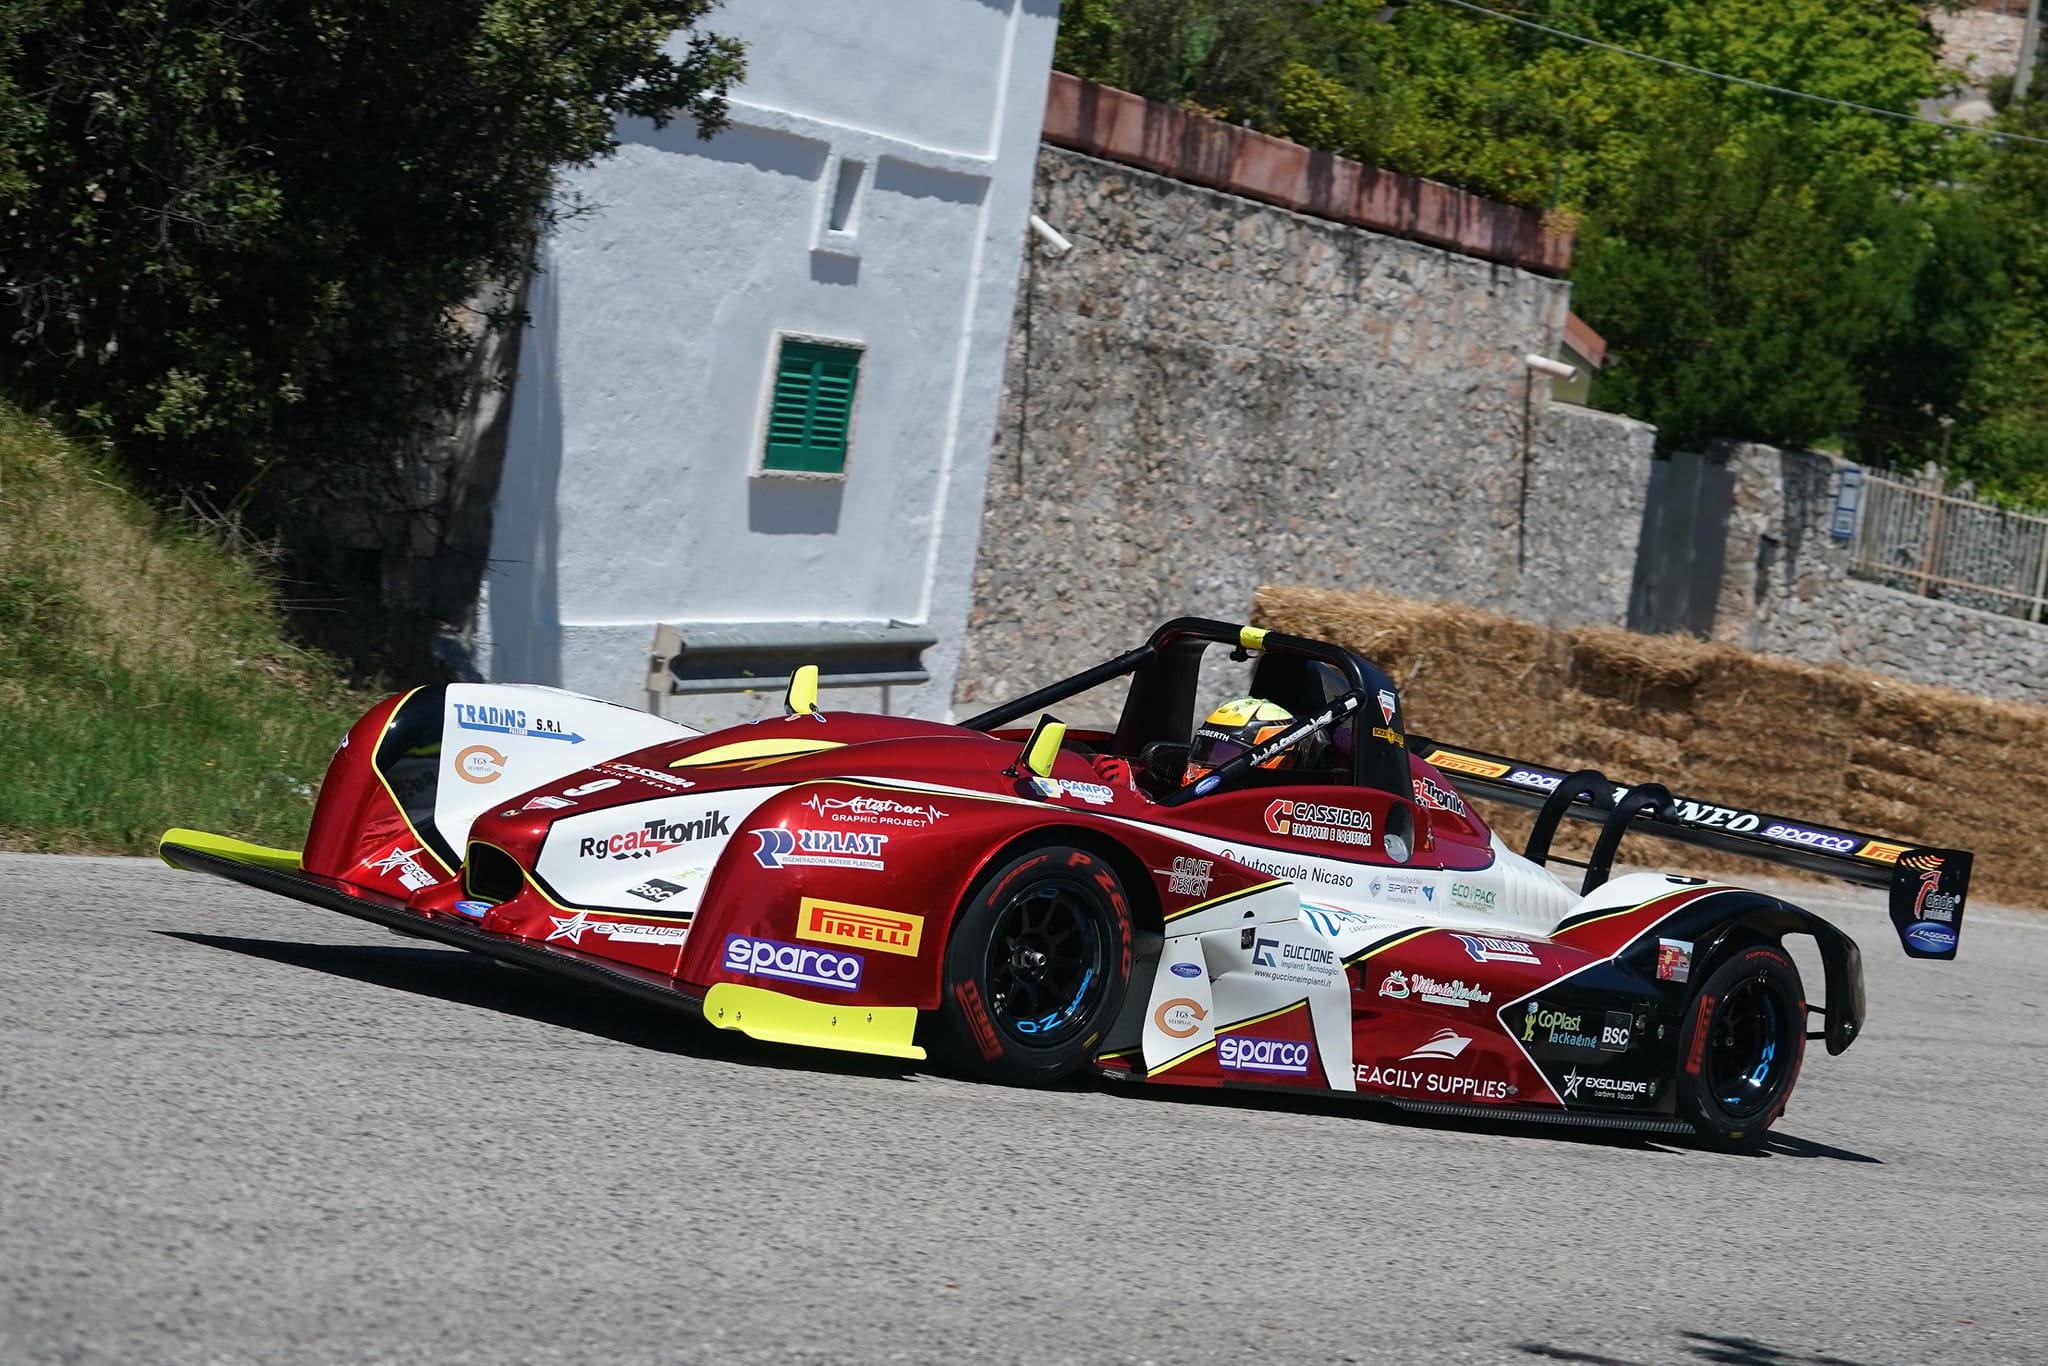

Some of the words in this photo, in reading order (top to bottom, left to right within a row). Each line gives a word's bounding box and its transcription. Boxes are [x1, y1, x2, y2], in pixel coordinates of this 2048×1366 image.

[453, 703, 527, 729] TRADING
[472, 757, 487, 765] TGS
[1430, 754, 1502, 777] PIRELLI
[639, 778, 677, 792] TEAM
[1060, 780, 1113, 797] CAMPO
[831, 813, 878, 824] GRAPHIC
[879, 816, 928, 828] PROJECT
[1294, 802, 1372, 830] CASSIBBA
[579, 810, 731, 860] RgcarTronik
[799, 829, 885, 855] RIPLAST
[1292, 823, 1329, 840] TRASPORTI
[1329, 829, 1336, 841] E
[1336, 830, 1372, 846] LOGISTICA
[1763, 824, 1855, 852] sparco
[827, 859, 853, 867] MATERIE
[1168, 875, 1209, 899] DESIGN
[1311, 867, 1354, 888] Nicaso
[634, 883, 674, 901] BSC
[808, 906, 914, 948] PIRELLI
[726, 937, 861, 990] sparco
[1282, 943, 1335, 965] GUCCIONE
[1253, 970, 1332, 988] www.guccioneimpianti.it
[1175, 1010, 1189, 1018] TGS
[1601, 1026, 1630, 1046] BSC
[1219, 1037, 1309, 1072] sparco
[1426, 1073, 1508, 1099] SUPPLIES
[1585, 1077, 1648, 1093] EXSCLUSIVE
